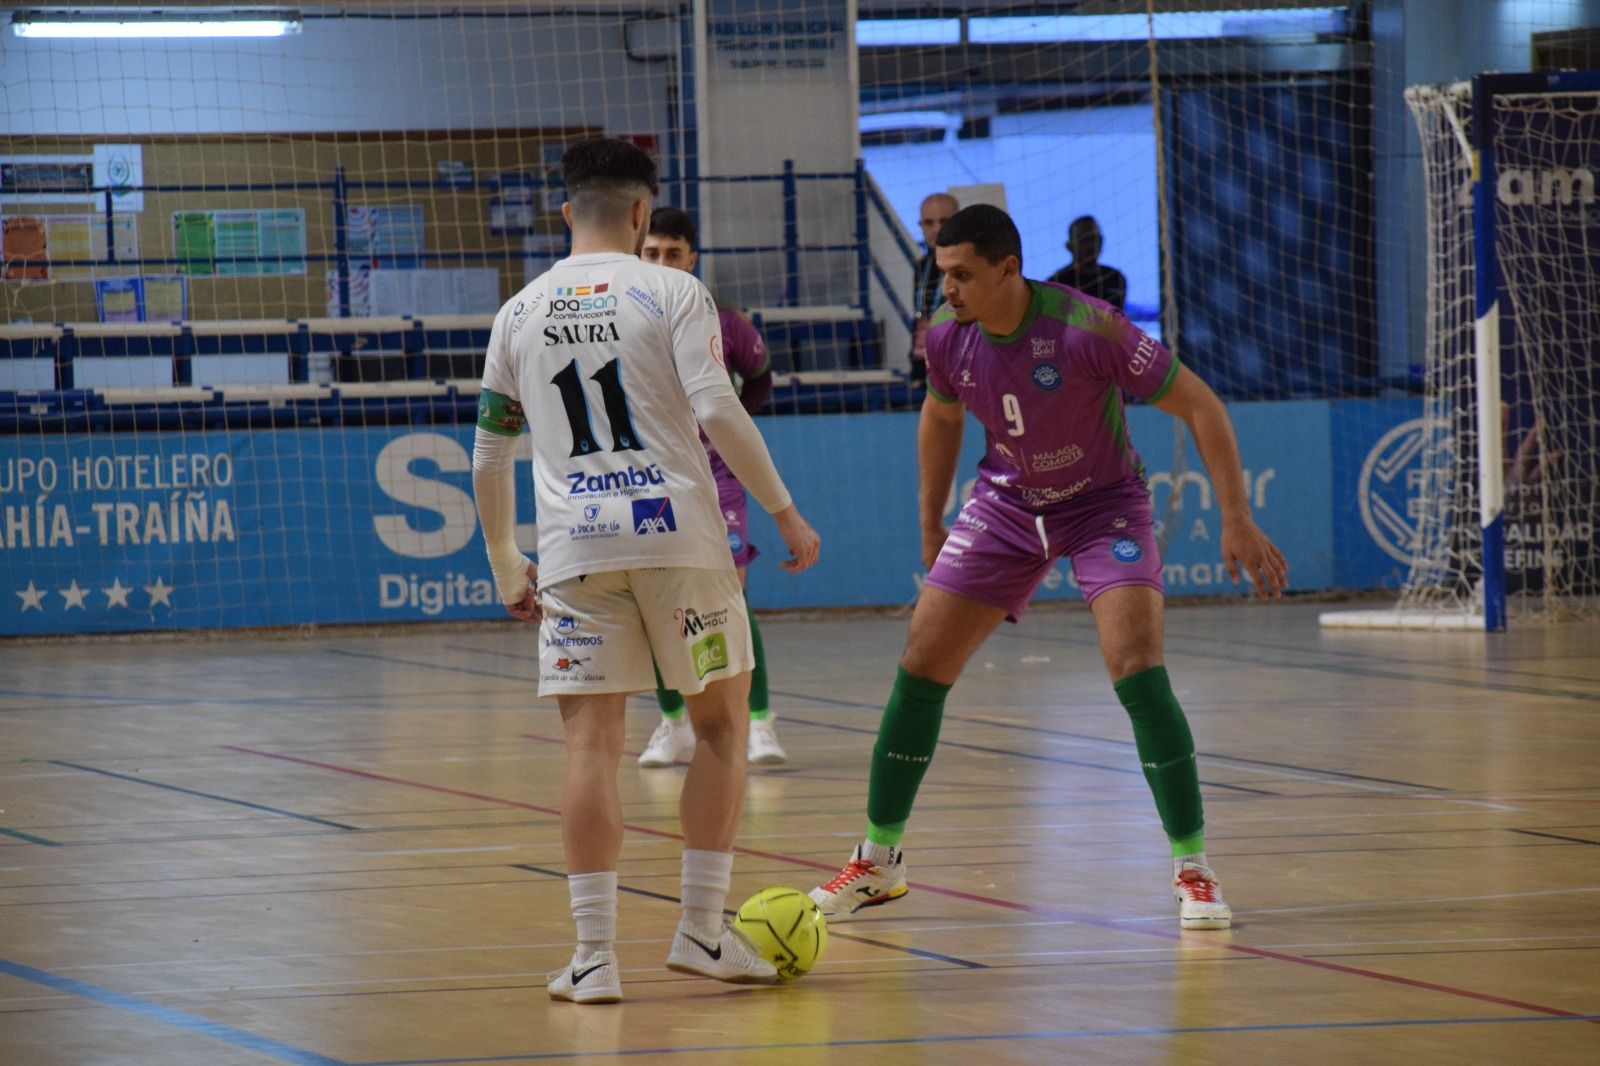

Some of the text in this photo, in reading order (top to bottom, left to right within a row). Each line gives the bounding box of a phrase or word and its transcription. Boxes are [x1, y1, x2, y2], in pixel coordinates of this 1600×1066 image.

[545, 294, 618, 318] joasan
[553, 310, 617, 320] construcciones
[543, 322, 620, 346] SAURA
[549, 357, 645, 458] 11
[1002, 394, 1025, 437] 9
[72, 453, 233, 491] HOTELERO
[566, 464, 666, 494] Zambú
[0, 491, 235, 549] HÍA-TRAÍÑA
[635, 517, 670, 536] AXA
[1501, 523, 1593, 543] ALIDAD
[1503, 549, 1564, 569] EFINE
